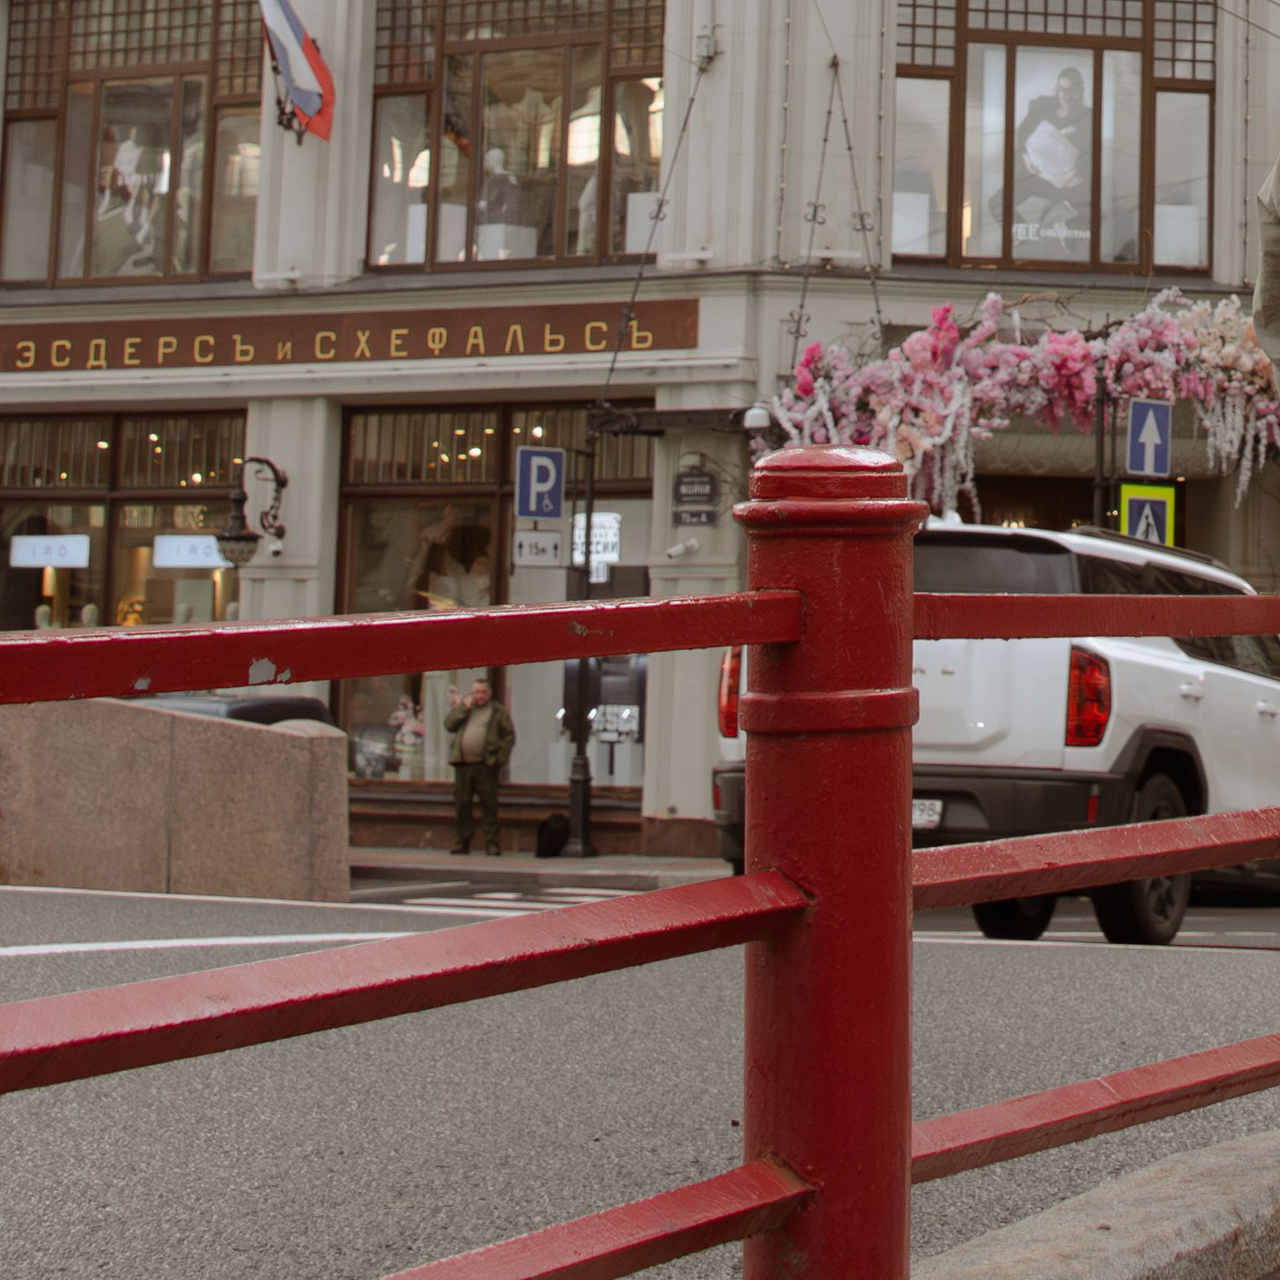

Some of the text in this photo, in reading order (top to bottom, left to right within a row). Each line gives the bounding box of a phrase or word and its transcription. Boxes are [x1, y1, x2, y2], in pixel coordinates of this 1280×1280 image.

[15, 334, 255, 370] ЭСДЕРСЪ
[314, 320, 654, 360] СХЕФАЛЬСЪ
[529, 456, 557, 512] P
